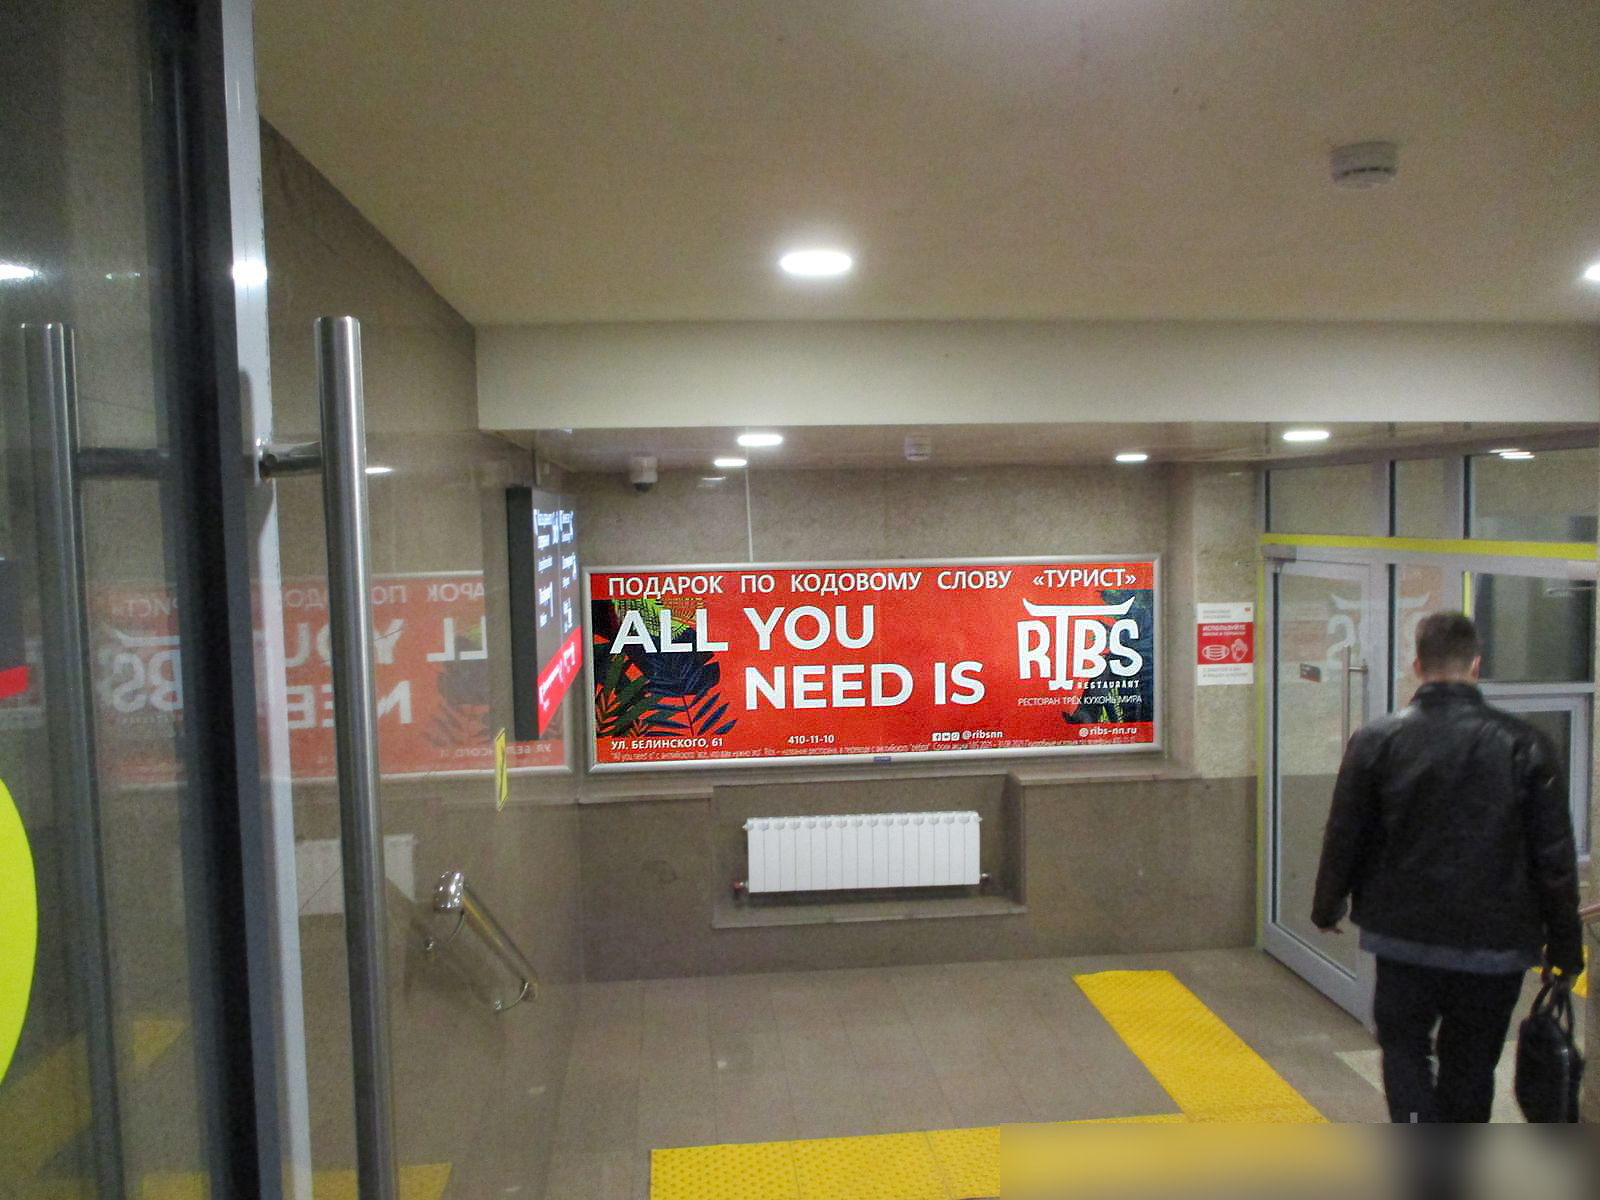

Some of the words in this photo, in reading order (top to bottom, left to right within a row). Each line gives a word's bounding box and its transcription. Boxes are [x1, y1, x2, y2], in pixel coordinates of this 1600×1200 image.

[608, 576, 723, 599] ПОДАРОК
[741, 574, 775, 593] ПО
[791, 572, 922, 596] КОДОВОМУ
[937, 570, 1011, 590] СЛОВУ
[1033, 569, 1136, 588] «ТУРИСТ»
[610, 608, 728, 654] ALL
[743, 604, 874, 650] YOU
[1017, 596, 1143, 690] RIBS
[745, 664, 914, 710] NEED
[935, 661, 985, 705] IS
[1077, 680, 1140, 689] RESTAURANT
[1018, 696, 1060, 706] РЕСТОРАН
[1118, 694, 1143, 704] МИРА
[611, 740, 628, 750] УЛ.
[632, 738, 709, 750] БЕЛИНСКОГО,
[711, 737, 723, 746] 61
[788, 735, 834, 745] 410-11-10
